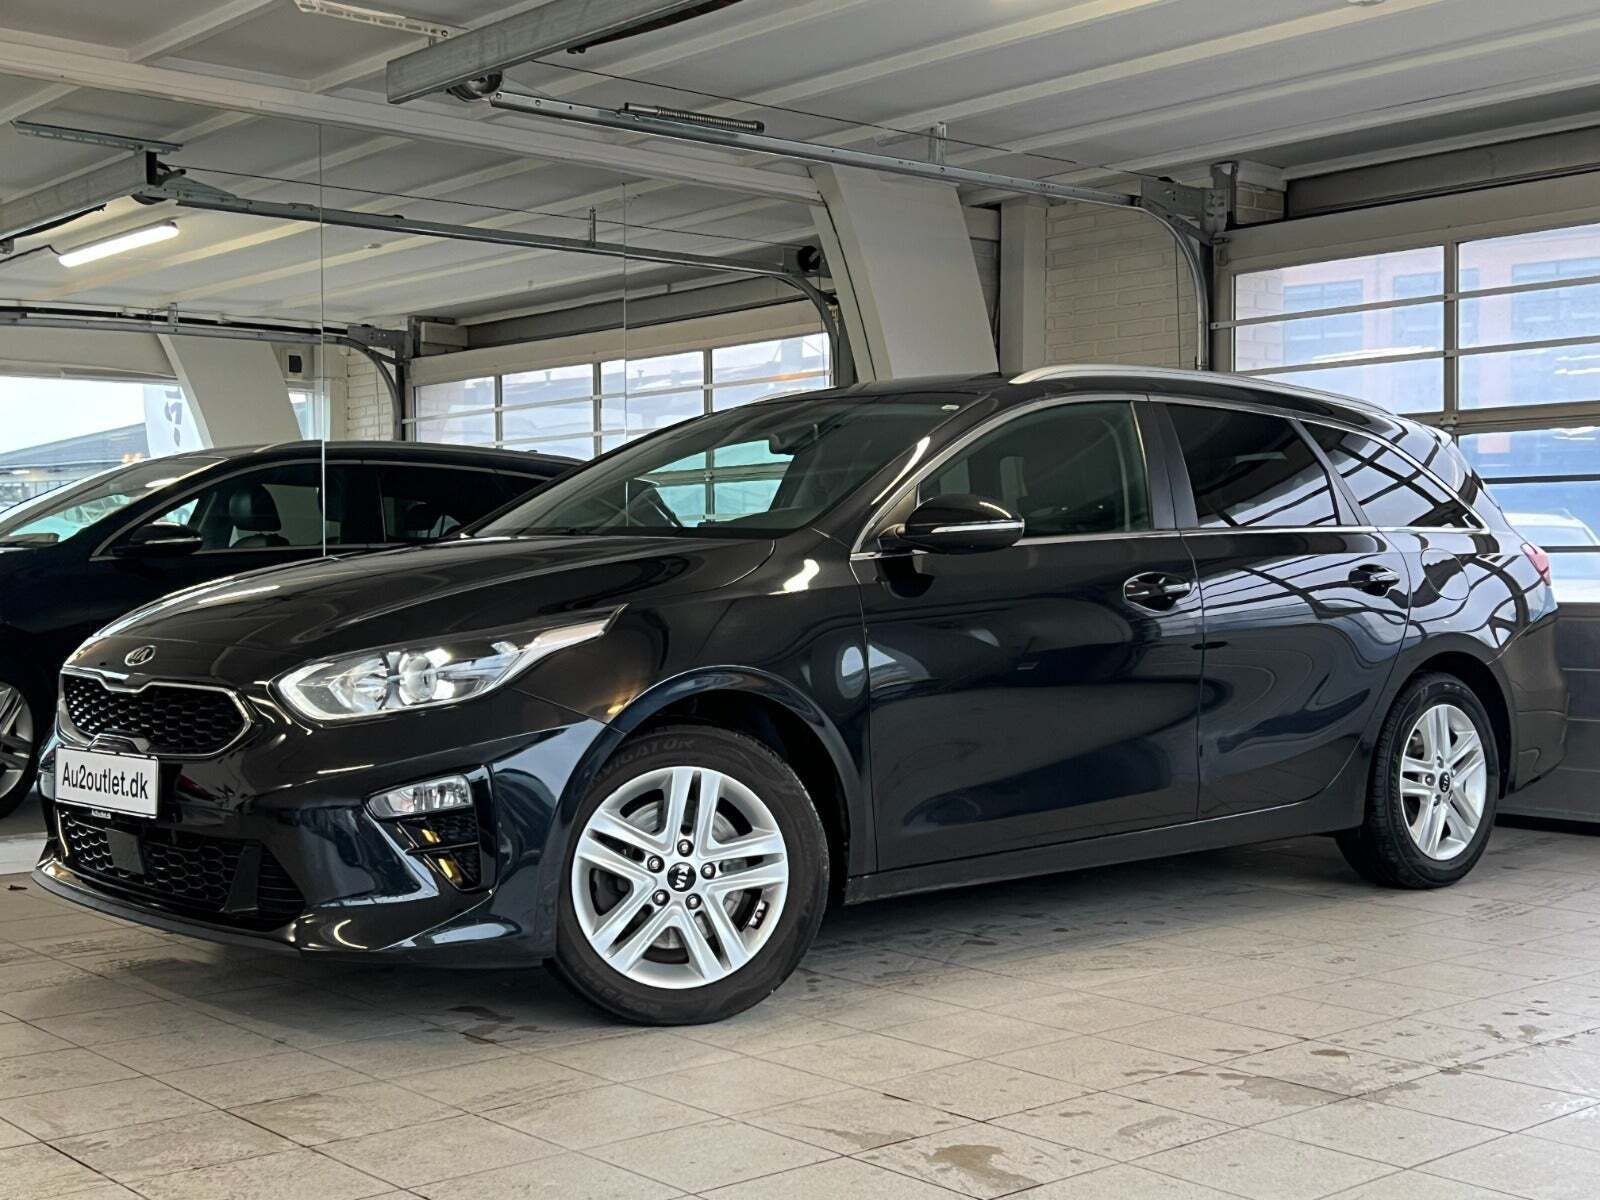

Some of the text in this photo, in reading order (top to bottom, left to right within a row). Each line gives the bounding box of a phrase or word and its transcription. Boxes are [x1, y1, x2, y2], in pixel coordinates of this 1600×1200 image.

[127, 648, 152, 665] KIA
[62, 762, 148, 799] Au2outlet.dk
[674, 864, 691, 888] KIA
